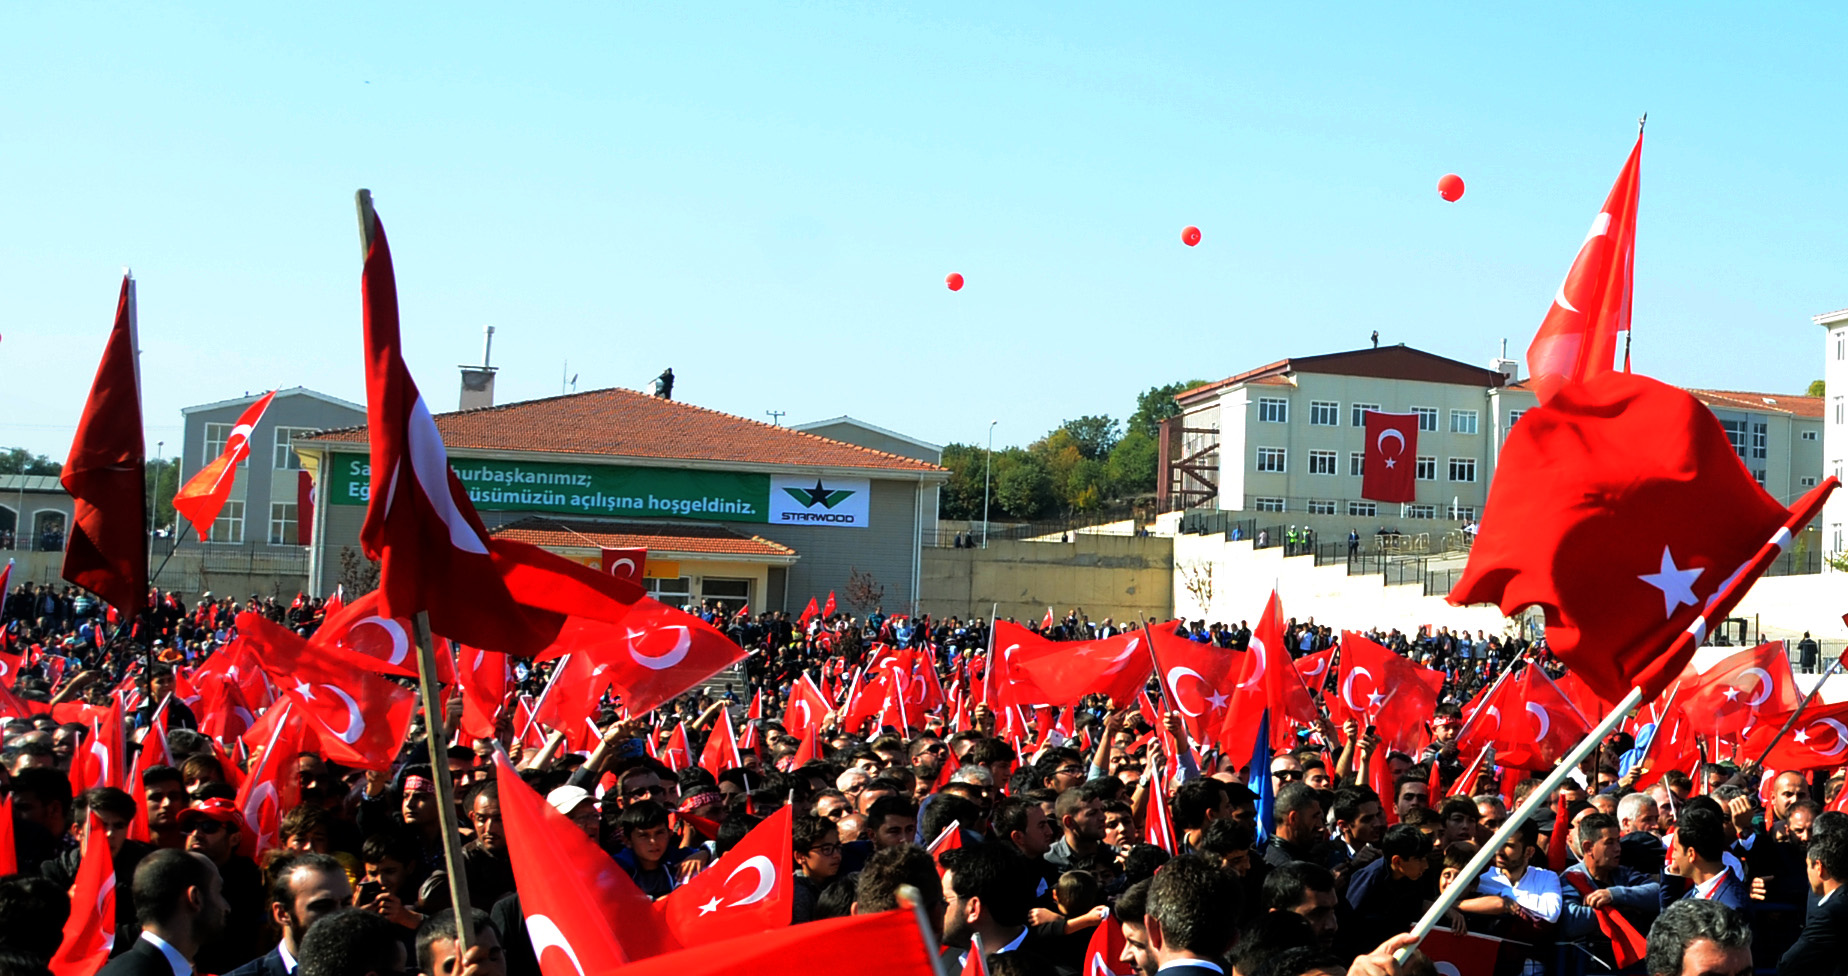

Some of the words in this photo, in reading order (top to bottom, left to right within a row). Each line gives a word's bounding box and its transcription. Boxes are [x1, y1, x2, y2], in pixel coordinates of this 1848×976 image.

[452, 465, 592, 488] hurbaşkanımız;
[469, 487, 566, 506] üsümüzün
[570, 492, 643, 512] açılışına
[648, 494, 756, 515] hoşgeldiniz.
[781, 511, 854, 523] STARWOOD
